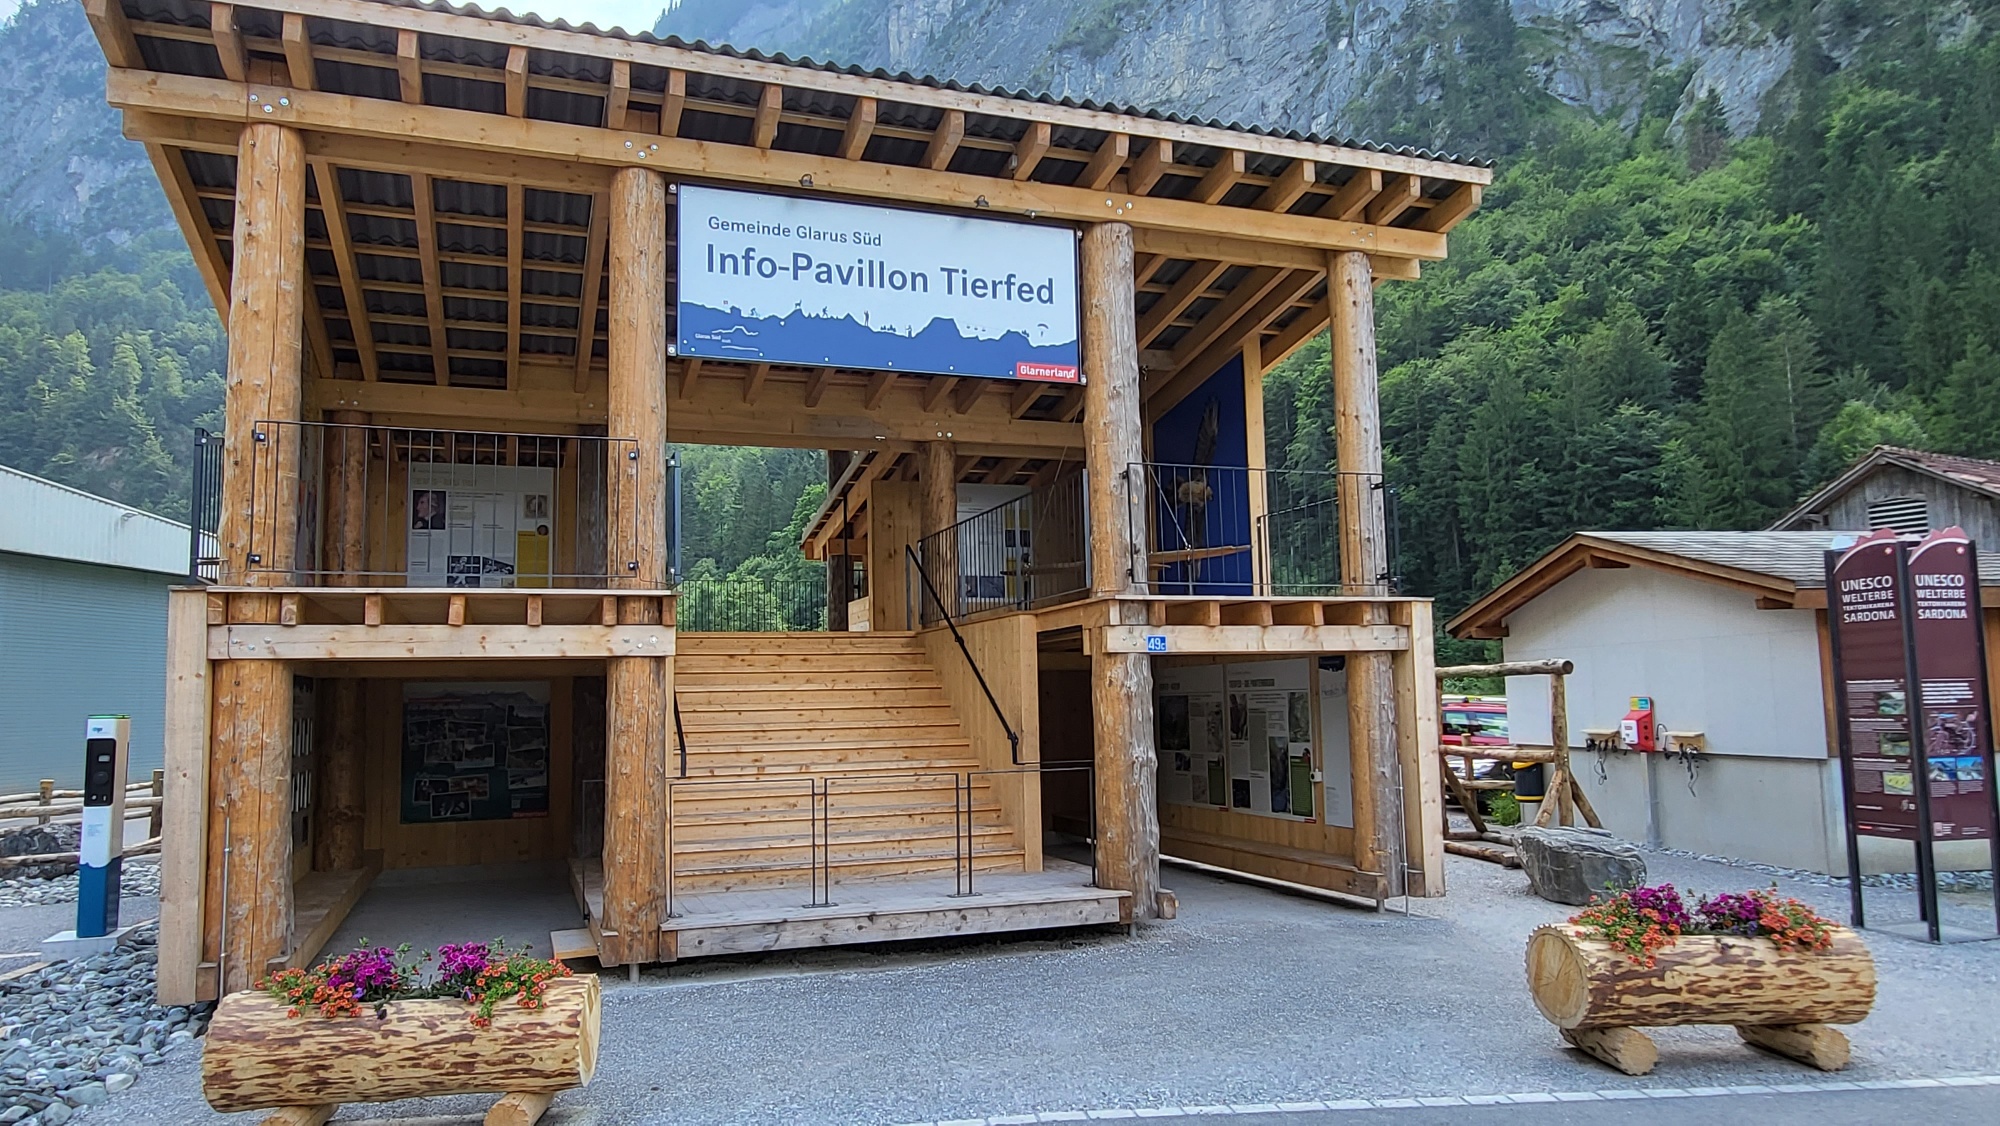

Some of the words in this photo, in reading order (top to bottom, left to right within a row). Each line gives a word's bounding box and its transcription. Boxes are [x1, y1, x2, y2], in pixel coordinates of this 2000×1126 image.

[708, 216, 792, 238] Gemeinde
[796, 225, 848, 244] Glarus
[852, 230, 882, 247] Süd
[706, 243, 929, 293] Info-Pavillon
[940, 266, 1054, 304] Tierfed
[1020, 365, 1075, 379] Glarnerland
[1841, 575, 1893, 592] UNESCO
[1915, 574, 1965, 587] UNESCO
[1842, 590, 1895, 603] WELTERBE
[1916, 589, 1966, 599] WELTERBE
[1842, 601, 1895, 611] TEKTONIKARENA
[1843, 610, 1896, 623] SARDONA
[1918, 609, 1968, 619] SARDONA
[1148, 637, 1166, 651] 49c
